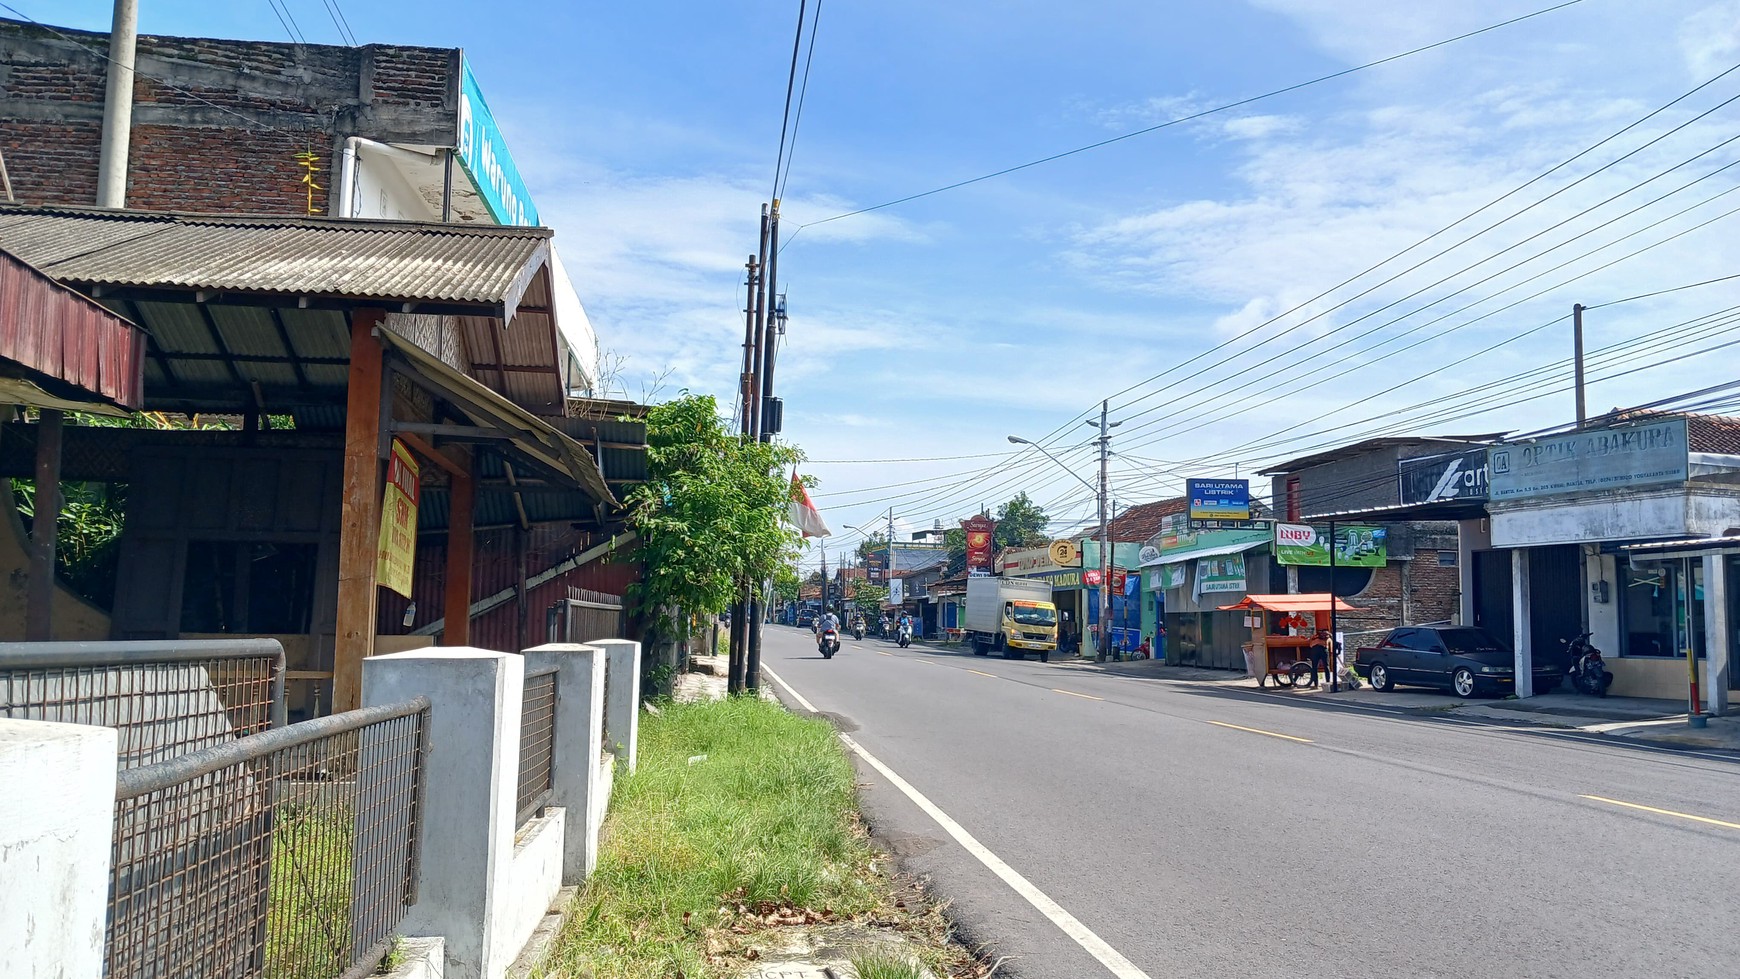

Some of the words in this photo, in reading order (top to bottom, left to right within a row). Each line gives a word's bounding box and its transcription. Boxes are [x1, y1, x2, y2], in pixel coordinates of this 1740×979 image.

[481, 124, 517, 226] Warung
[1280, 530, 1310, 540] LUBY
[1054, 572, 1080, 587] MADURA
